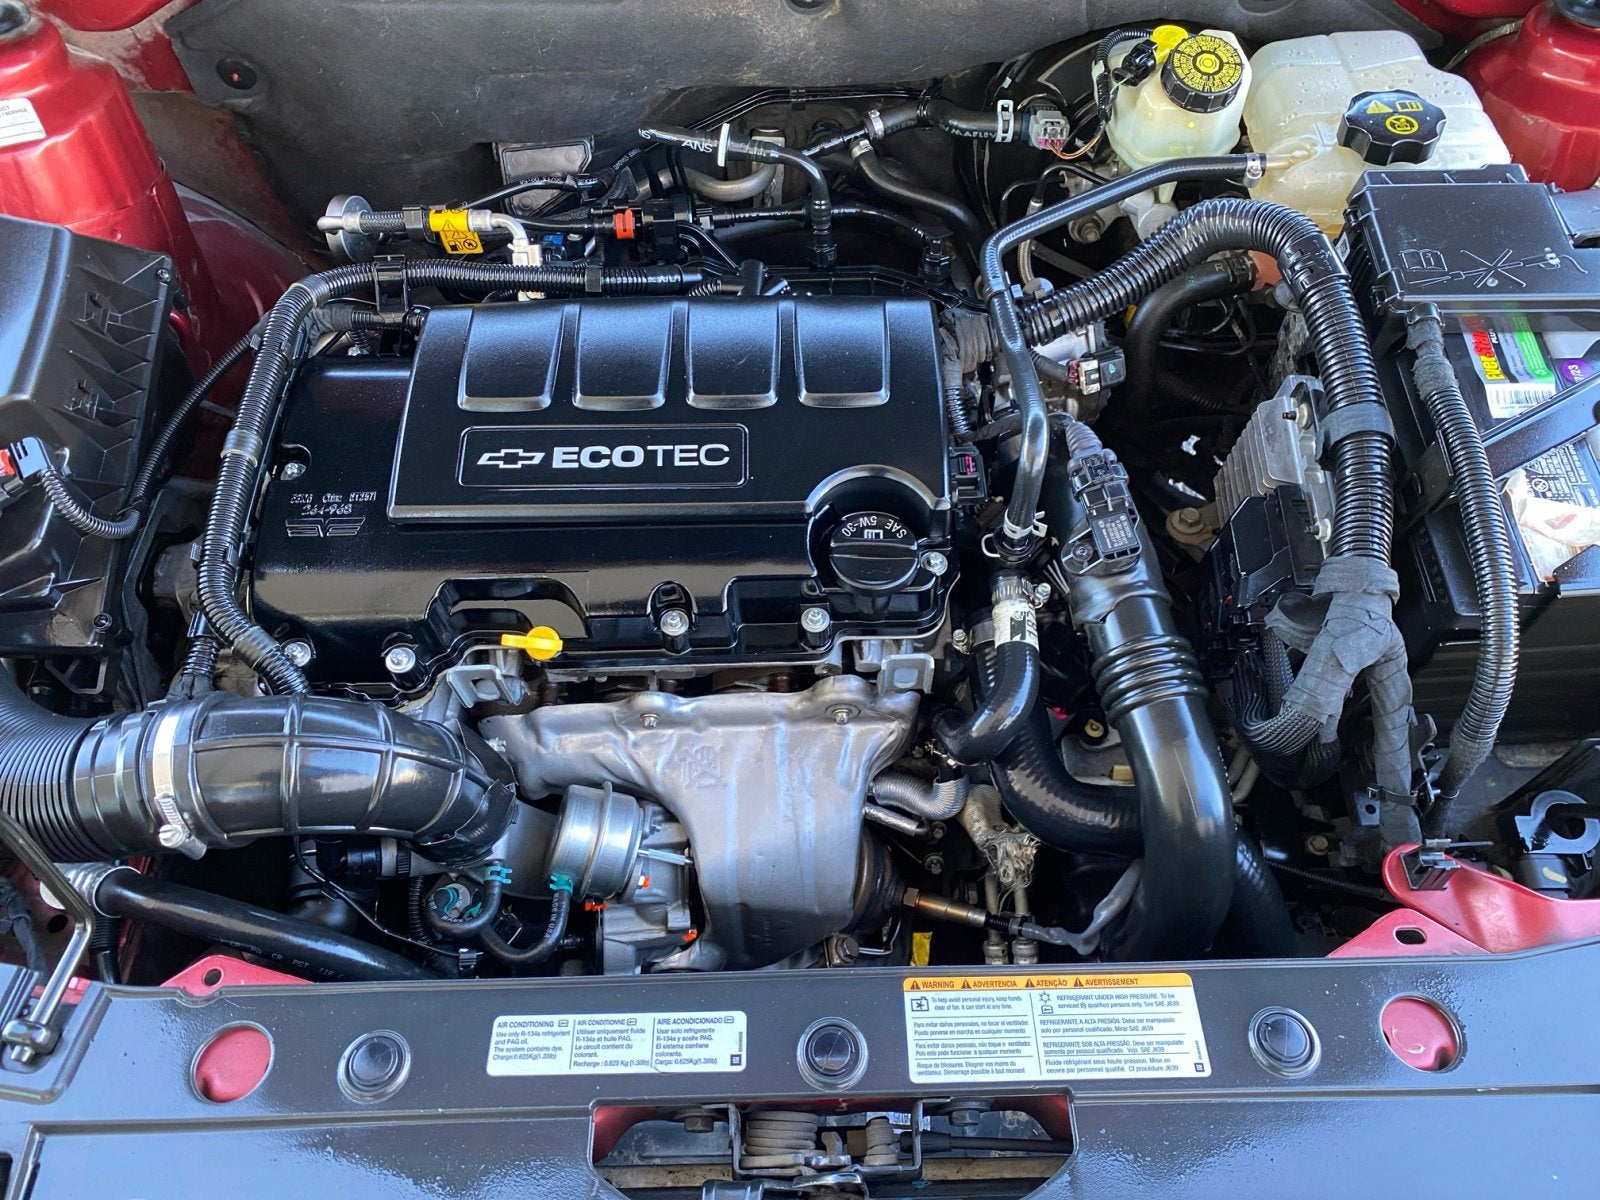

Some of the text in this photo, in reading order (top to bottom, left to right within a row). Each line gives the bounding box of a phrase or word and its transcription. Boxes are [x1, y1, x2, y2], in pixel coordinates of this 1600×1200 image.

[682, 139, 713, 153] ANS
[552, 443, 730, 468] ECOTEC
[841, 515, 907, 539] SAE 5W-30
[921, 978, 1139, 989] WARNING ADVERTENCIA ATENÇÃO AVERTISSEMENT
